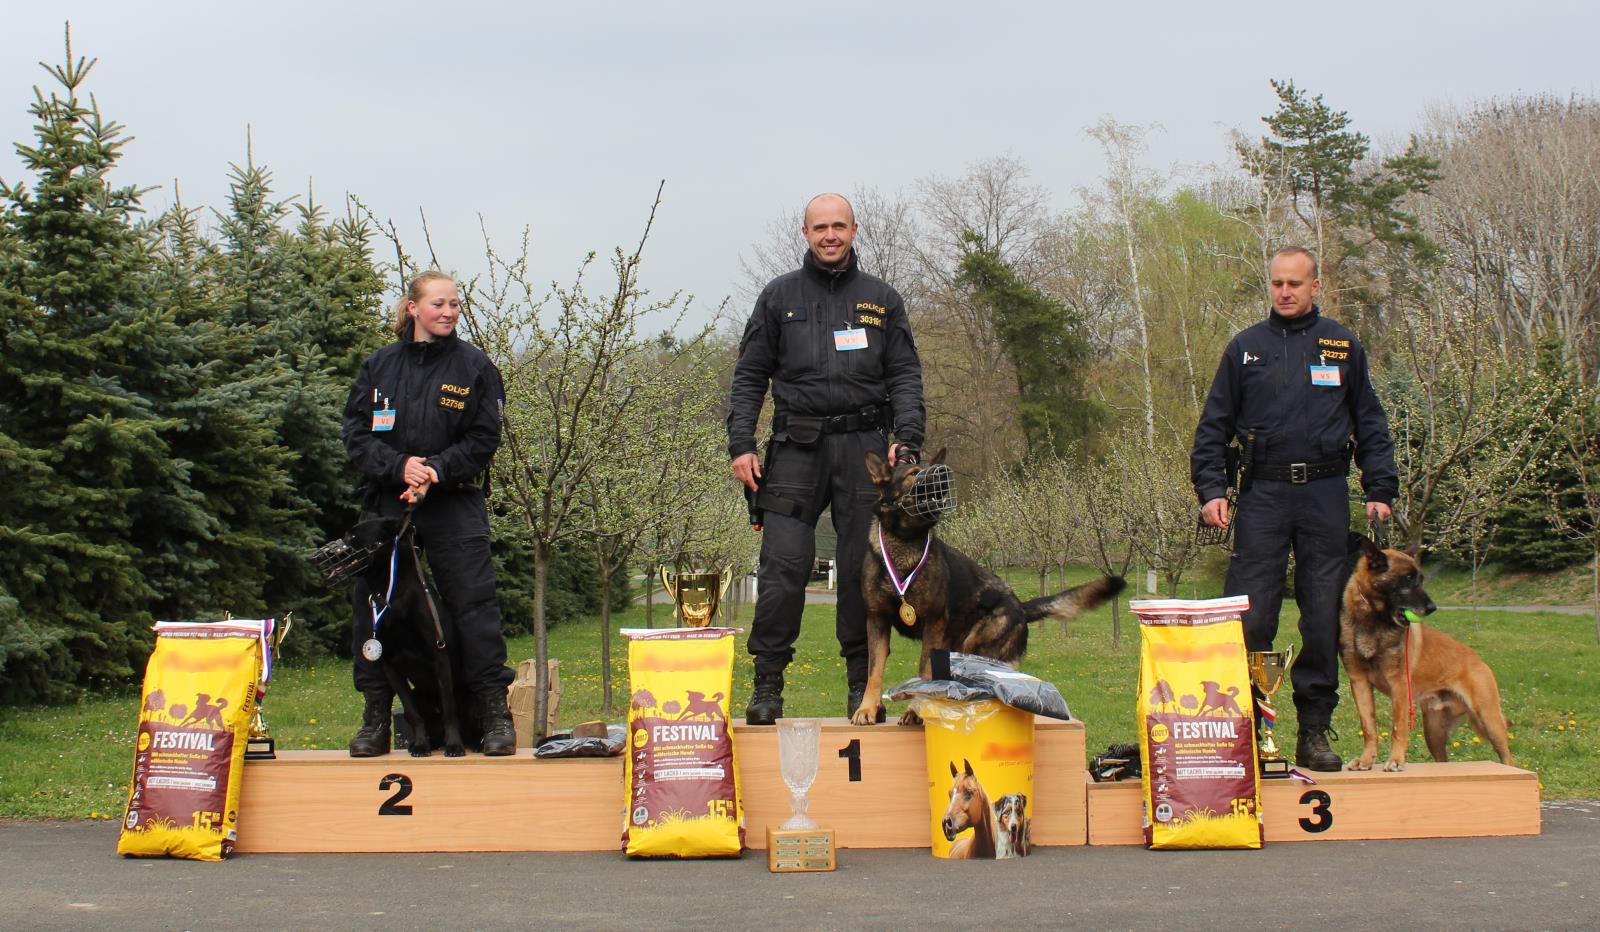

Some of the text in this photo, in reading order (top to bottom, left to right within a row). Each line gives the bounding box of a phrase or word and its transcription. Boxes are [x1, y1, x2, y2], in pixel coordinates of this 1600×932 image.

[856, 303, 886, 314] POLICIE
[1318, 338, 1350, 348] POLICIE
[1321, 350, 1348, 360] 322737
[242, 681, 255, 713] FESTIVAL
[653, 726, 720, 742] FESTIVAL
[1173, 722, 1239, 739] FESTIVAL
[153, 731, 215, 751] FESTIVAL
[839, 739, 861, 782] 1
[379, 774, 412, 816] 2
[707, 800, 727, 819] 15
[1230, 798, 1248, 816] 15
[1299, 790, 1332, 833] 3
[192, 811, 211, 831] 15
